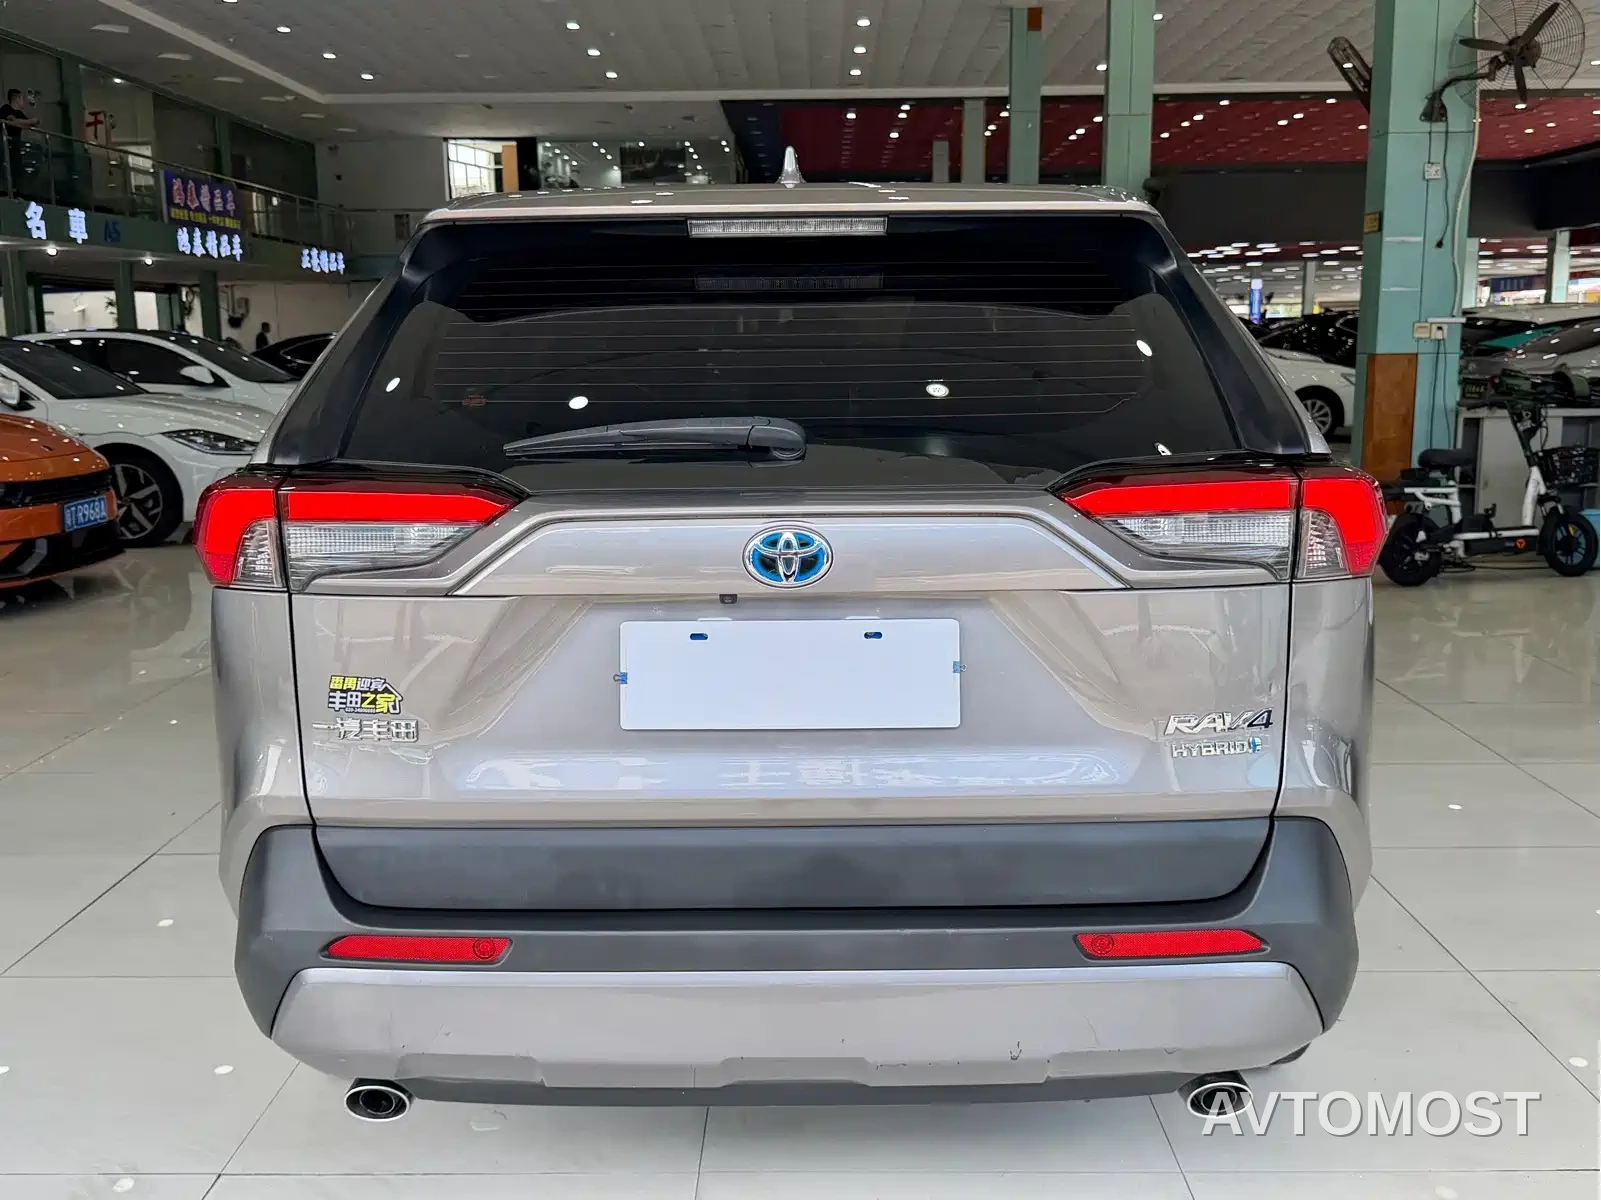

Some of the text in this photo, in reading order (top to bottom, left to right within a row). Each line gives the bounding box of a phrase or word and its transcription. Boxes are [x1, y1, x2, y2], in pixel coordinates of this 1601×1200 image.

[328, 691, 396, 713] 丰田之家
[312, 717, 419, 743] 一汽丰田
[1164, 707, 1274, 735] RAV4
[1171, 740, 1248, 758] HYBRID
